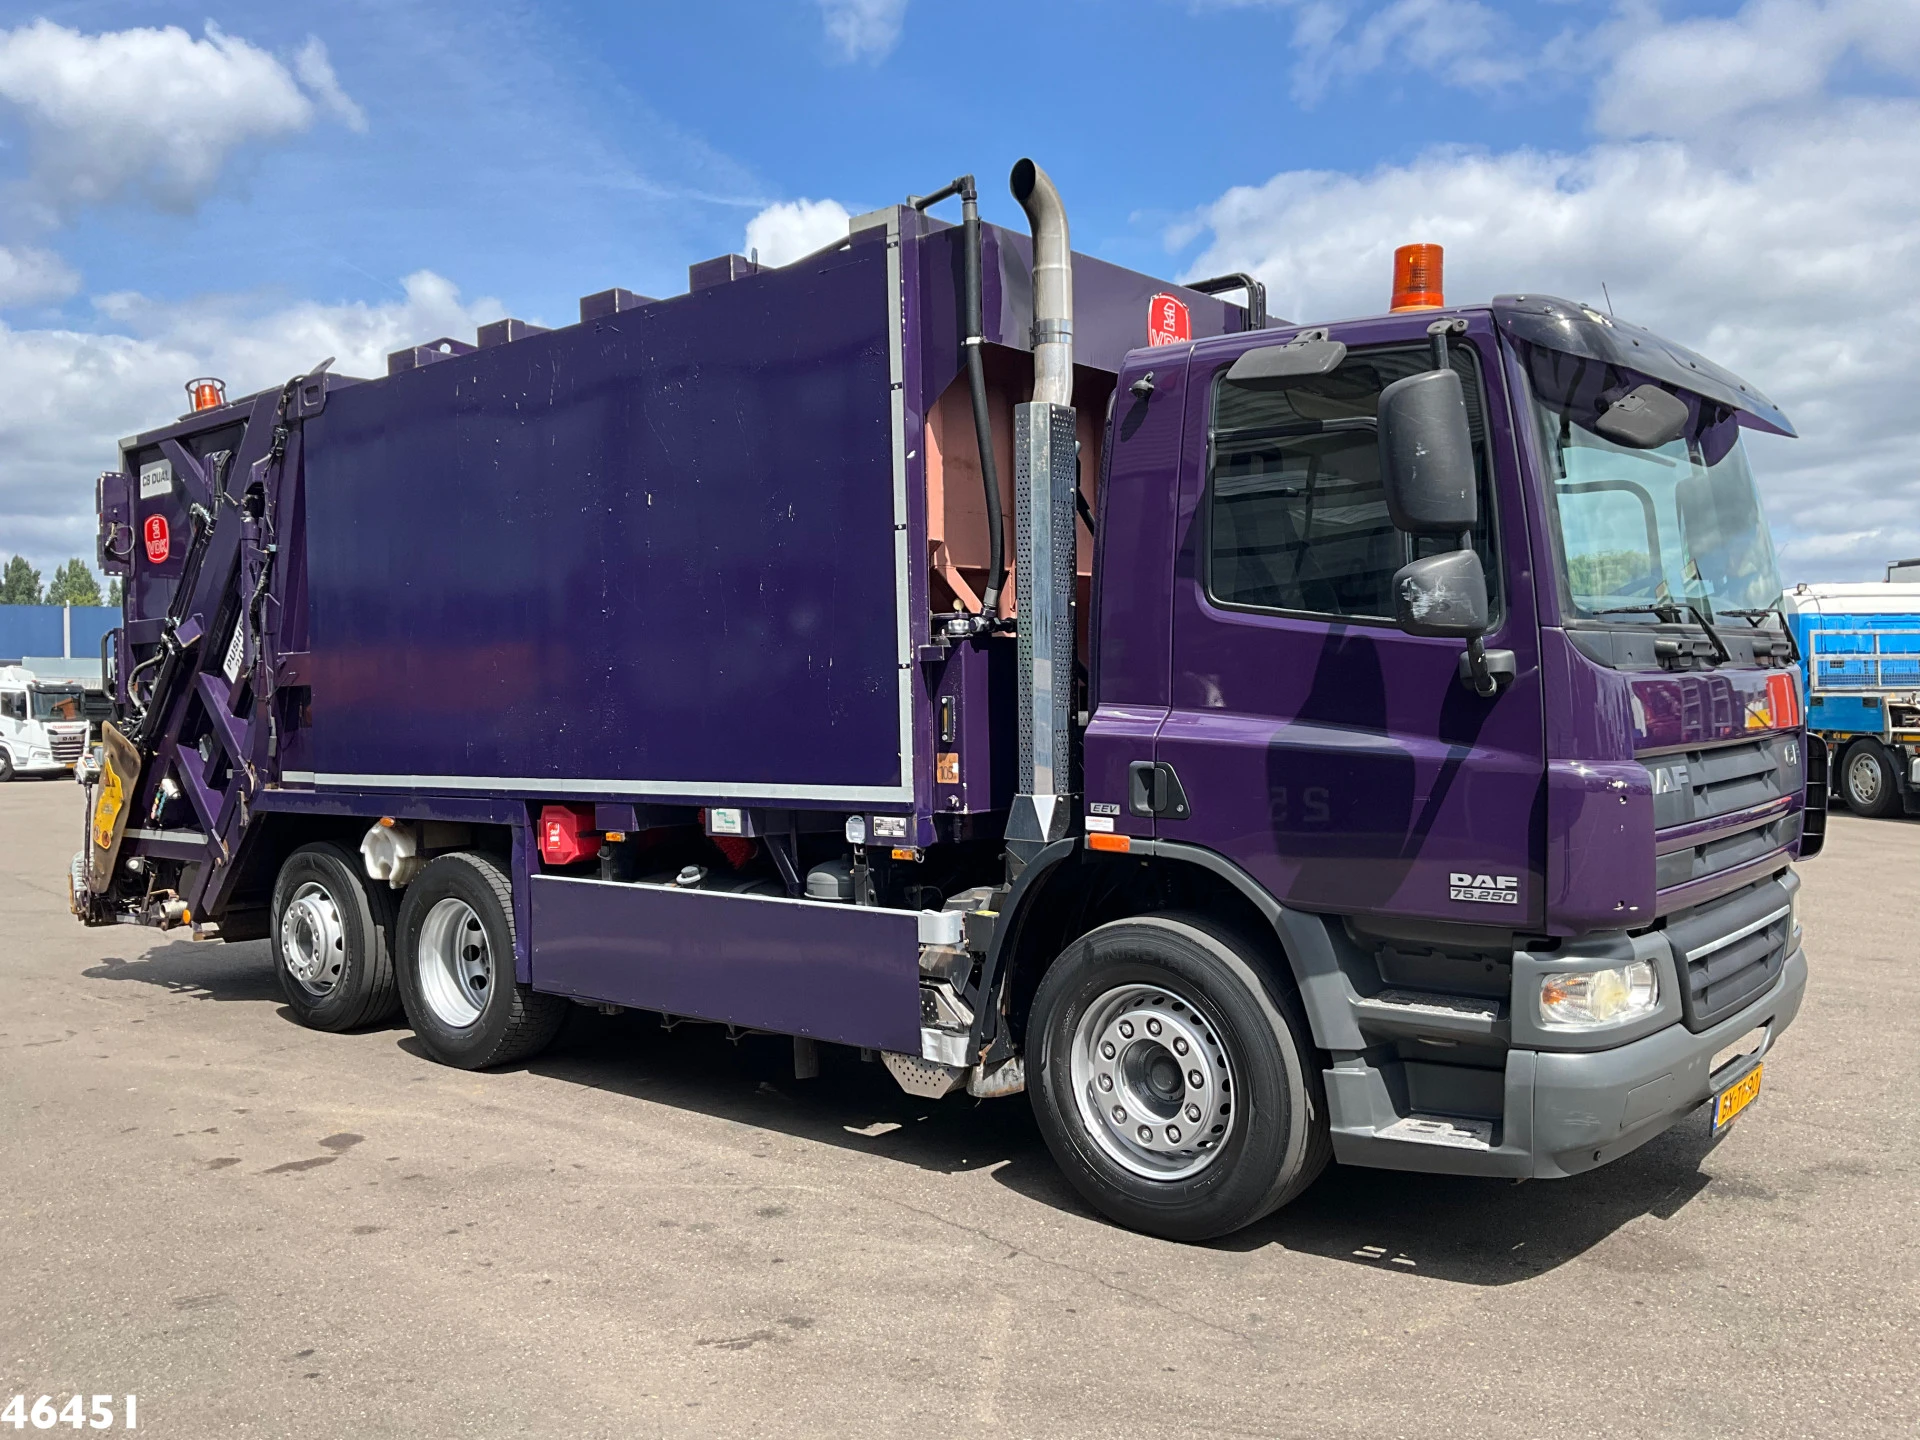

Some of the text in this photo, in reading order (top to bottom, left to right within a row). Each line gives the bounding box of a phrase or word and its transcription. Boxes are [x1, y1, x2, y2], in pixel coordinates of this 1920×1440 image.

[152, 469, 170, 485] DUAL
[147, 539, 168, 555] VDK
[1648, 765, 1690, 795] AF
[1092, 804, 1118, 813] EEV
[1450, 872, 1518, 889] DAF
[1451, 888, 1516, 902] 75.250
